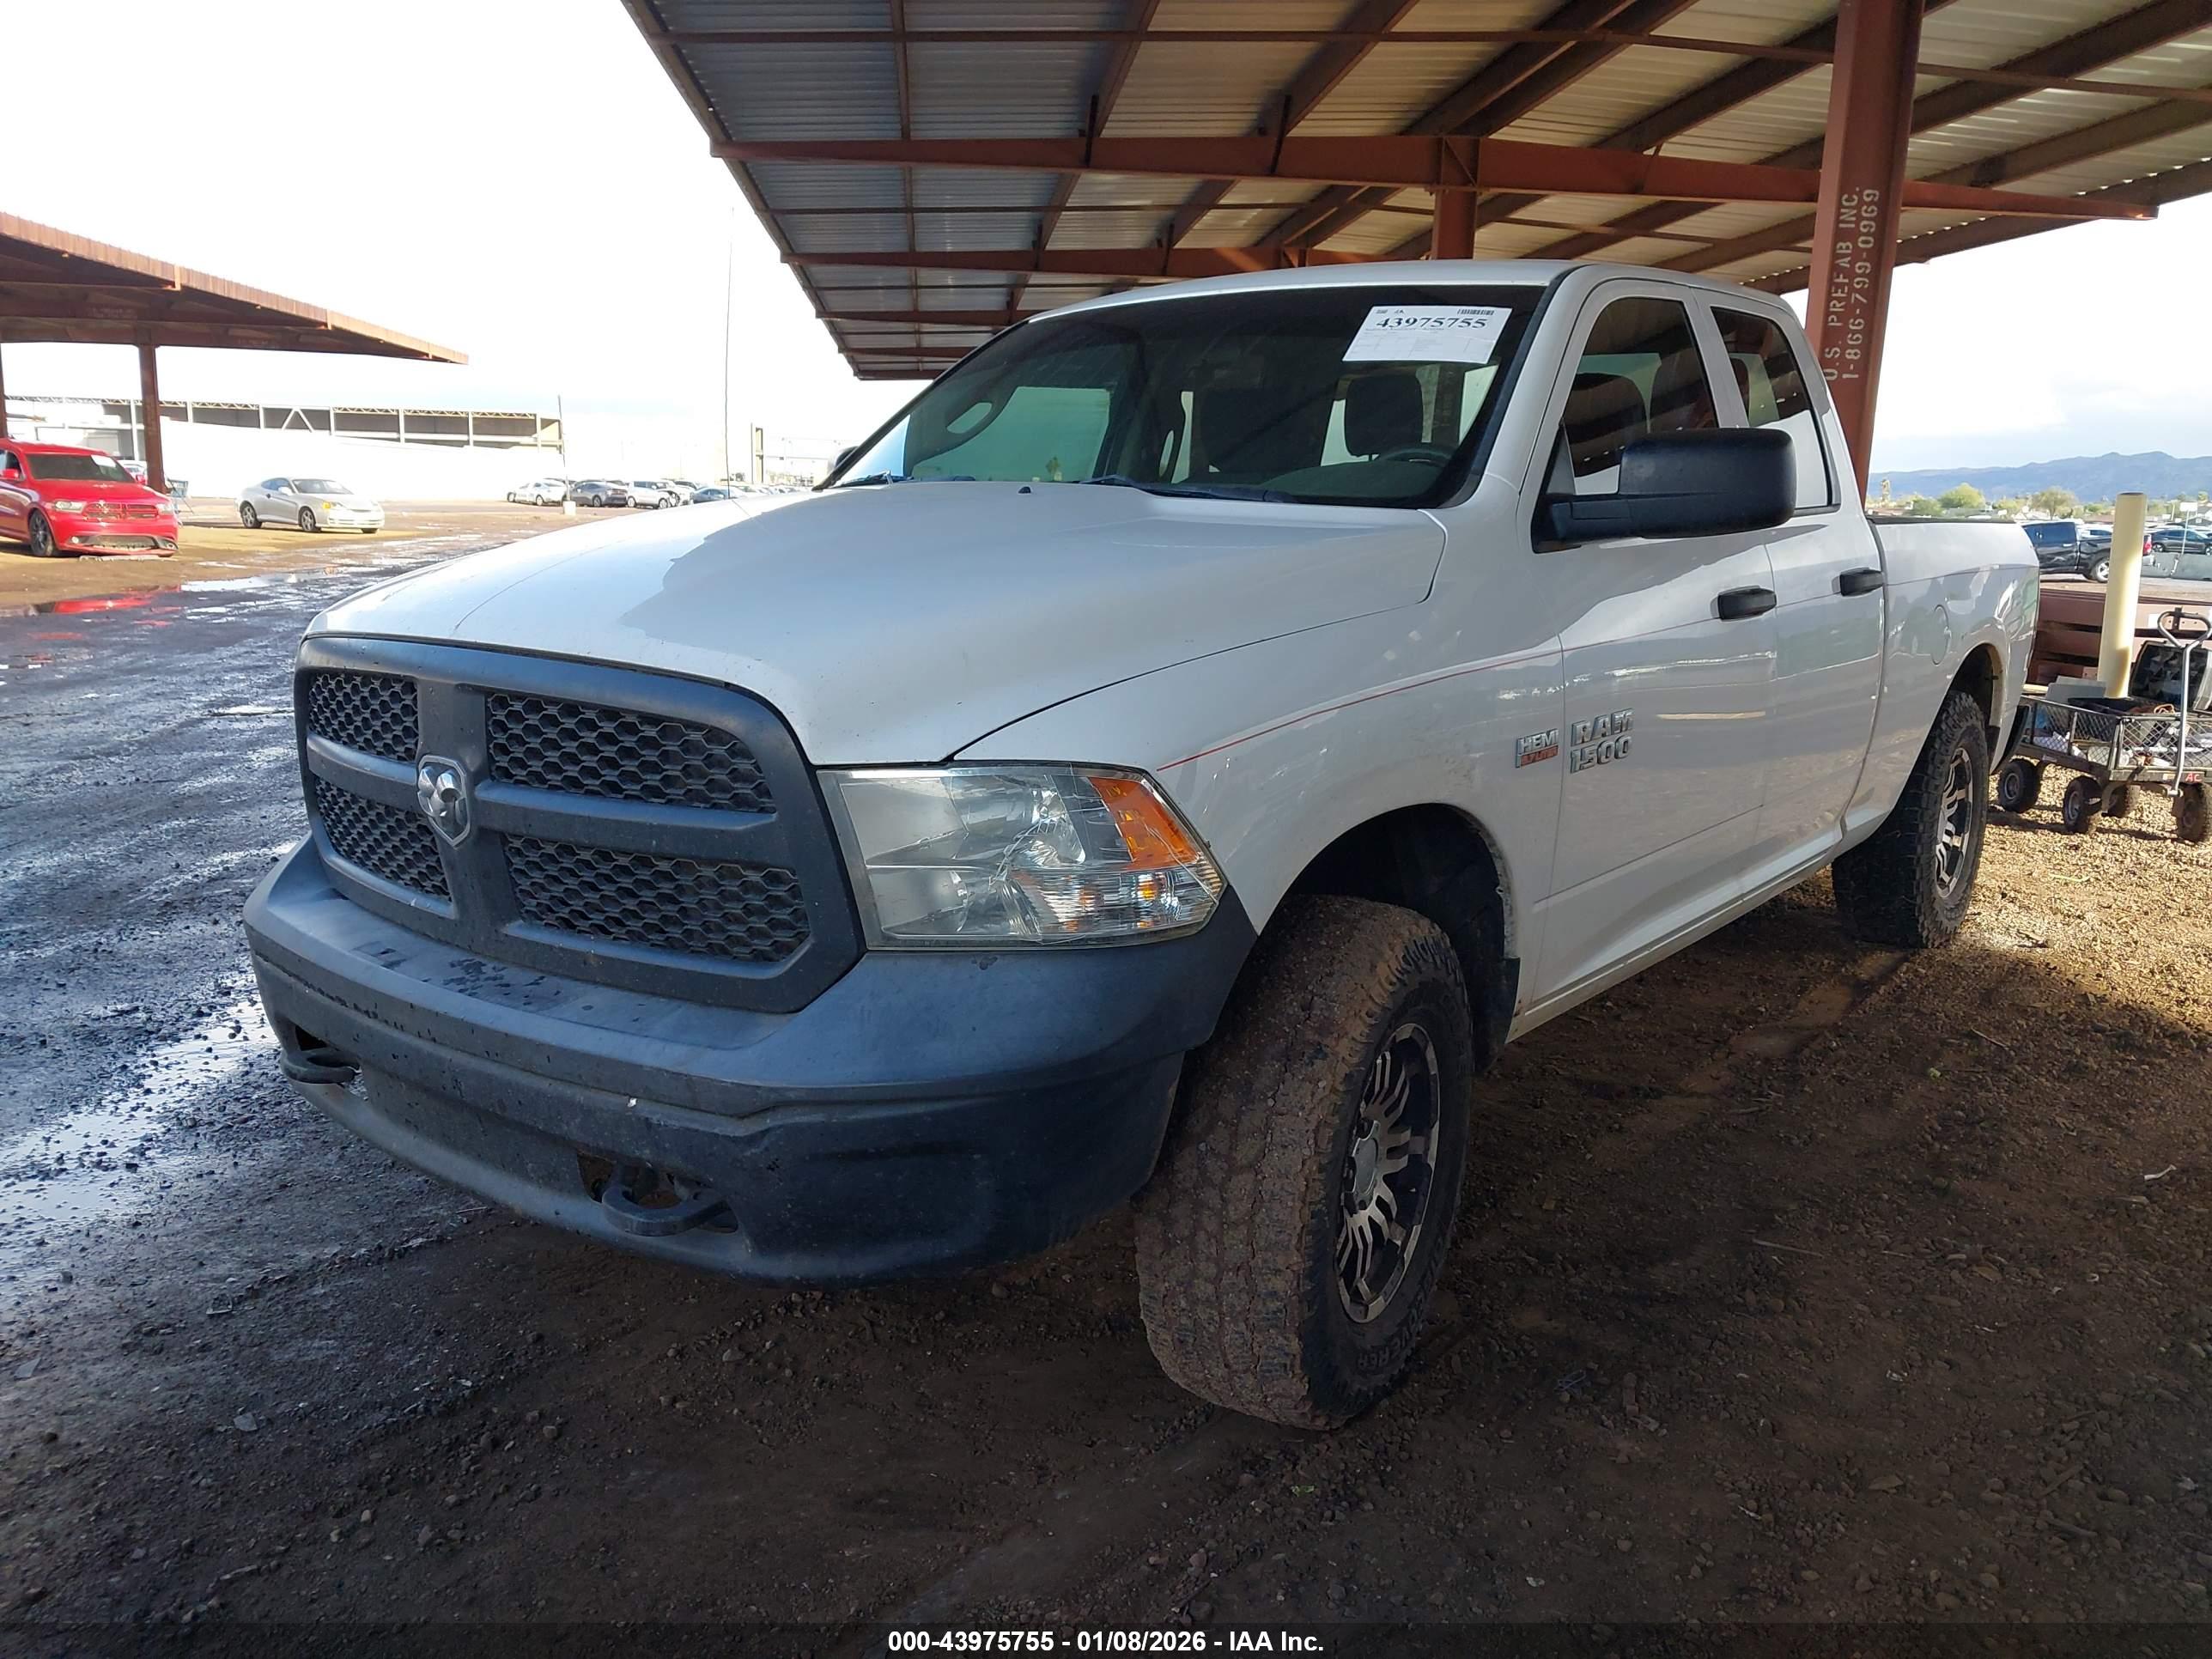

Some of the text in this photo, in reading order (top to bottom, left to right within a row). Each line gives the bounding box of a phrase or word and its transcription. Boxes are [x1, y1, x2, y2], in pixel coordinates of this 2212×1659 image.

[1823, 186, 1860, 380] U.S. PREFAB INC.
[1842, 189, 1880, 380] 1-866-799-0969
[1376, 317, 1488, 329] 43975755
[1516, 728, 1559, 757] HEMI
[1570, 708, 1635, 747] RAM
[1570, 735, 1632, 774] 1500
